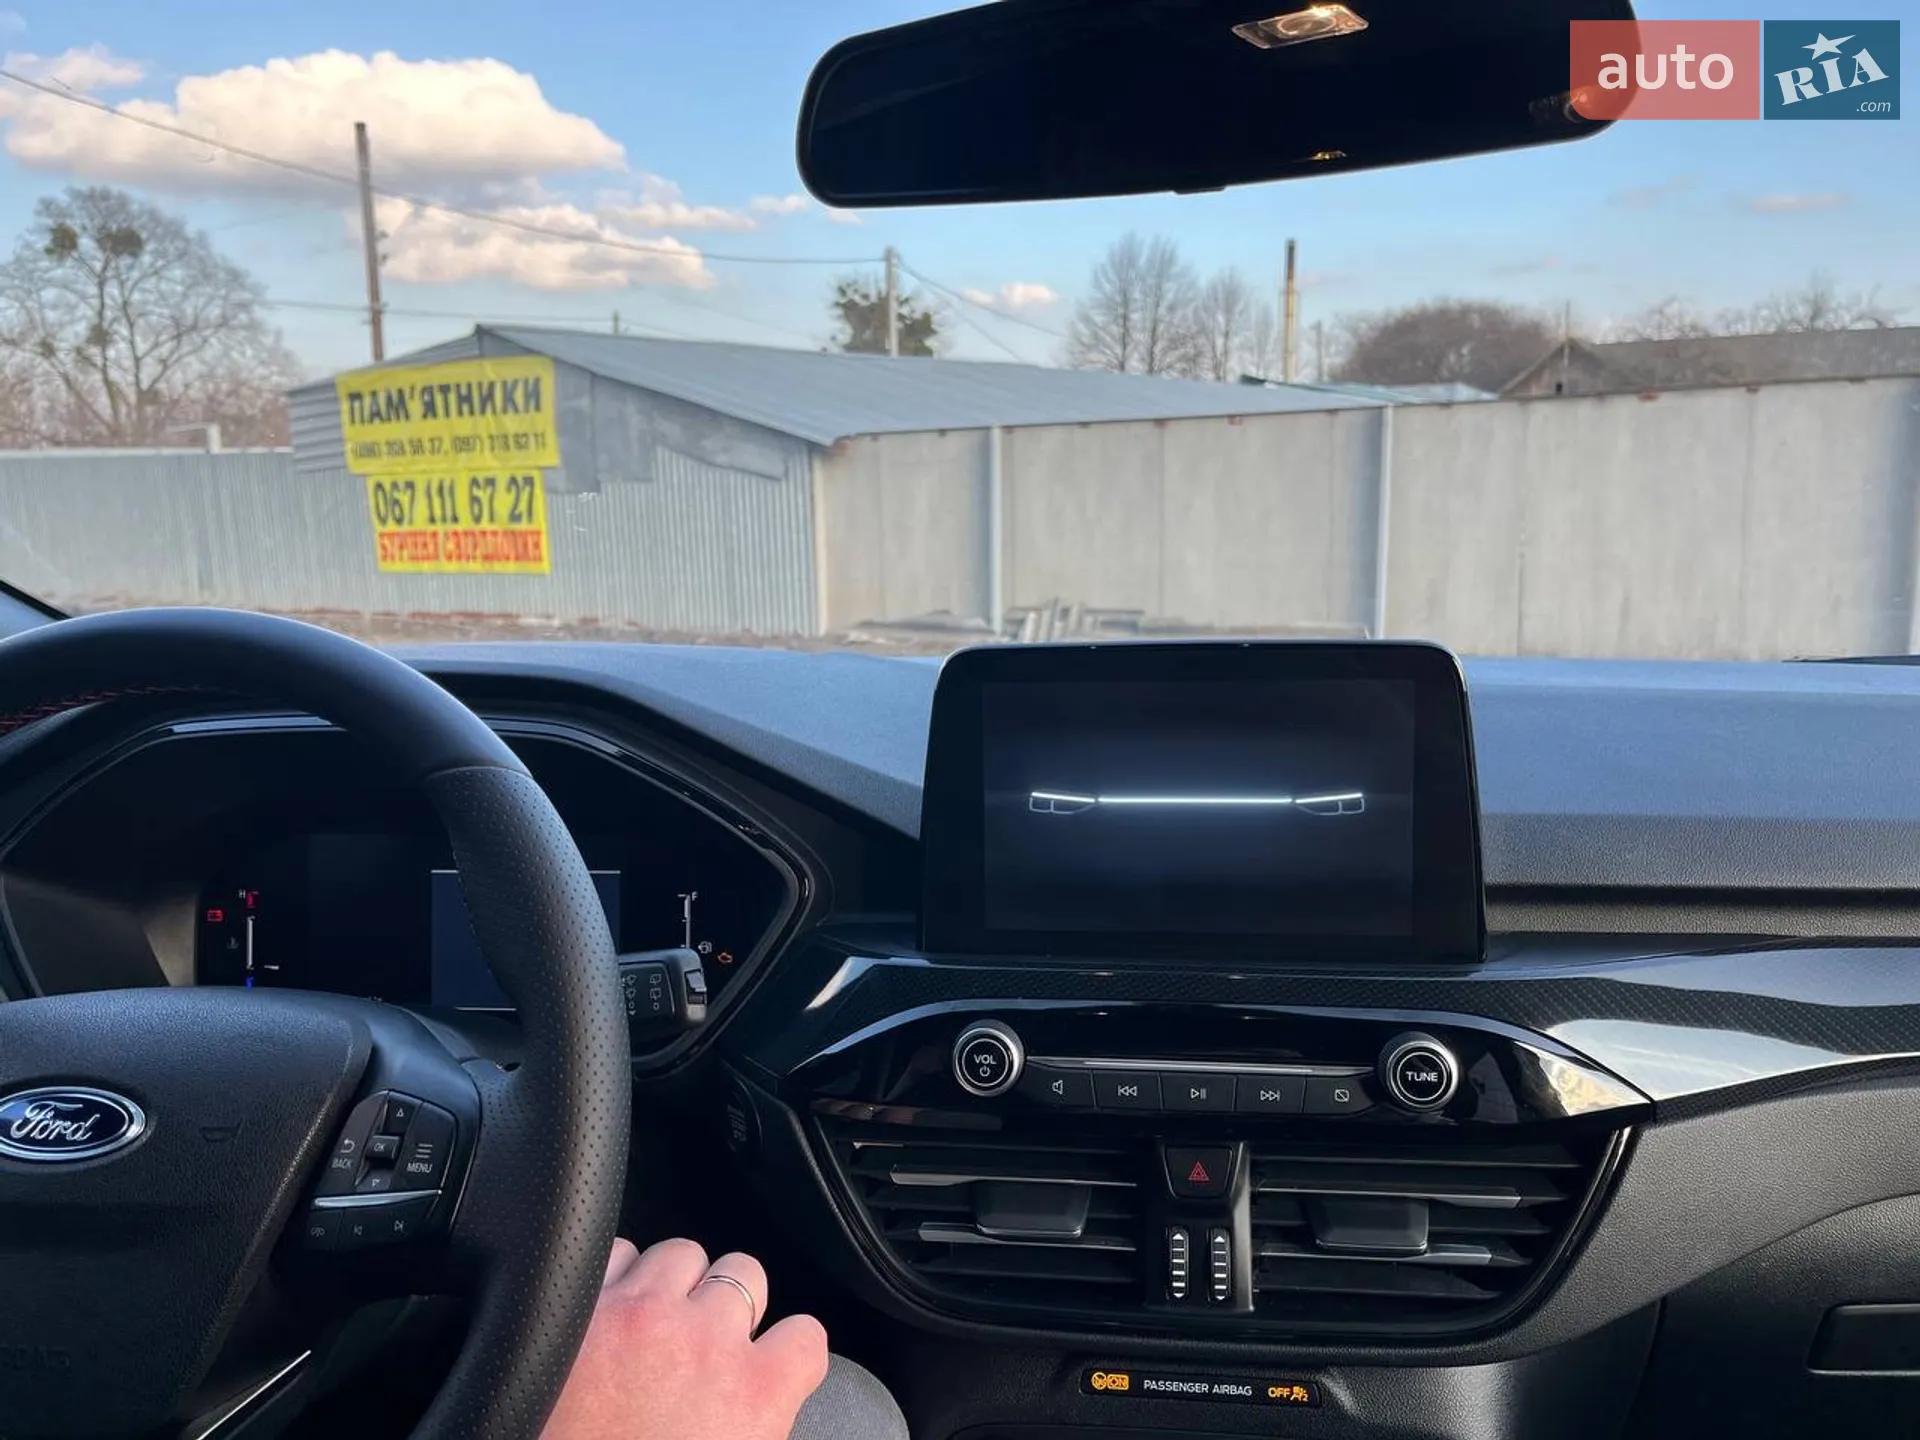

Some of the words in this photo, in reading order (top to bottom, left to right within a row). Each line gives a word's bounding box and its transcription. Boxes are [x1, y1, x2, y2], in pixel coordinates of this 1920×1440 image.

[348, 376, 541, 425] ПАМ'ЯТНИКИ
[374, 480, 416, 525] 067
[425, 478, 459, 525] 111
[469, 476, 496, 524] 67
[506, 475, 535, 523] 27
[973, 1054, 997, 1064] VOL
[1405, 1071, 1438, 1082] TUNE
[10, 1101, 100, 1141] Ford
[331, 1159, 353, 1169] BACK
[406, 1162, 433, 1174] MENU
[1143, 1380, 1209, 1394] PASSENGER
[1212, 1384, 1252, 1396] AIRBAG
[1267, 1387, 1290, 1398] OFF
